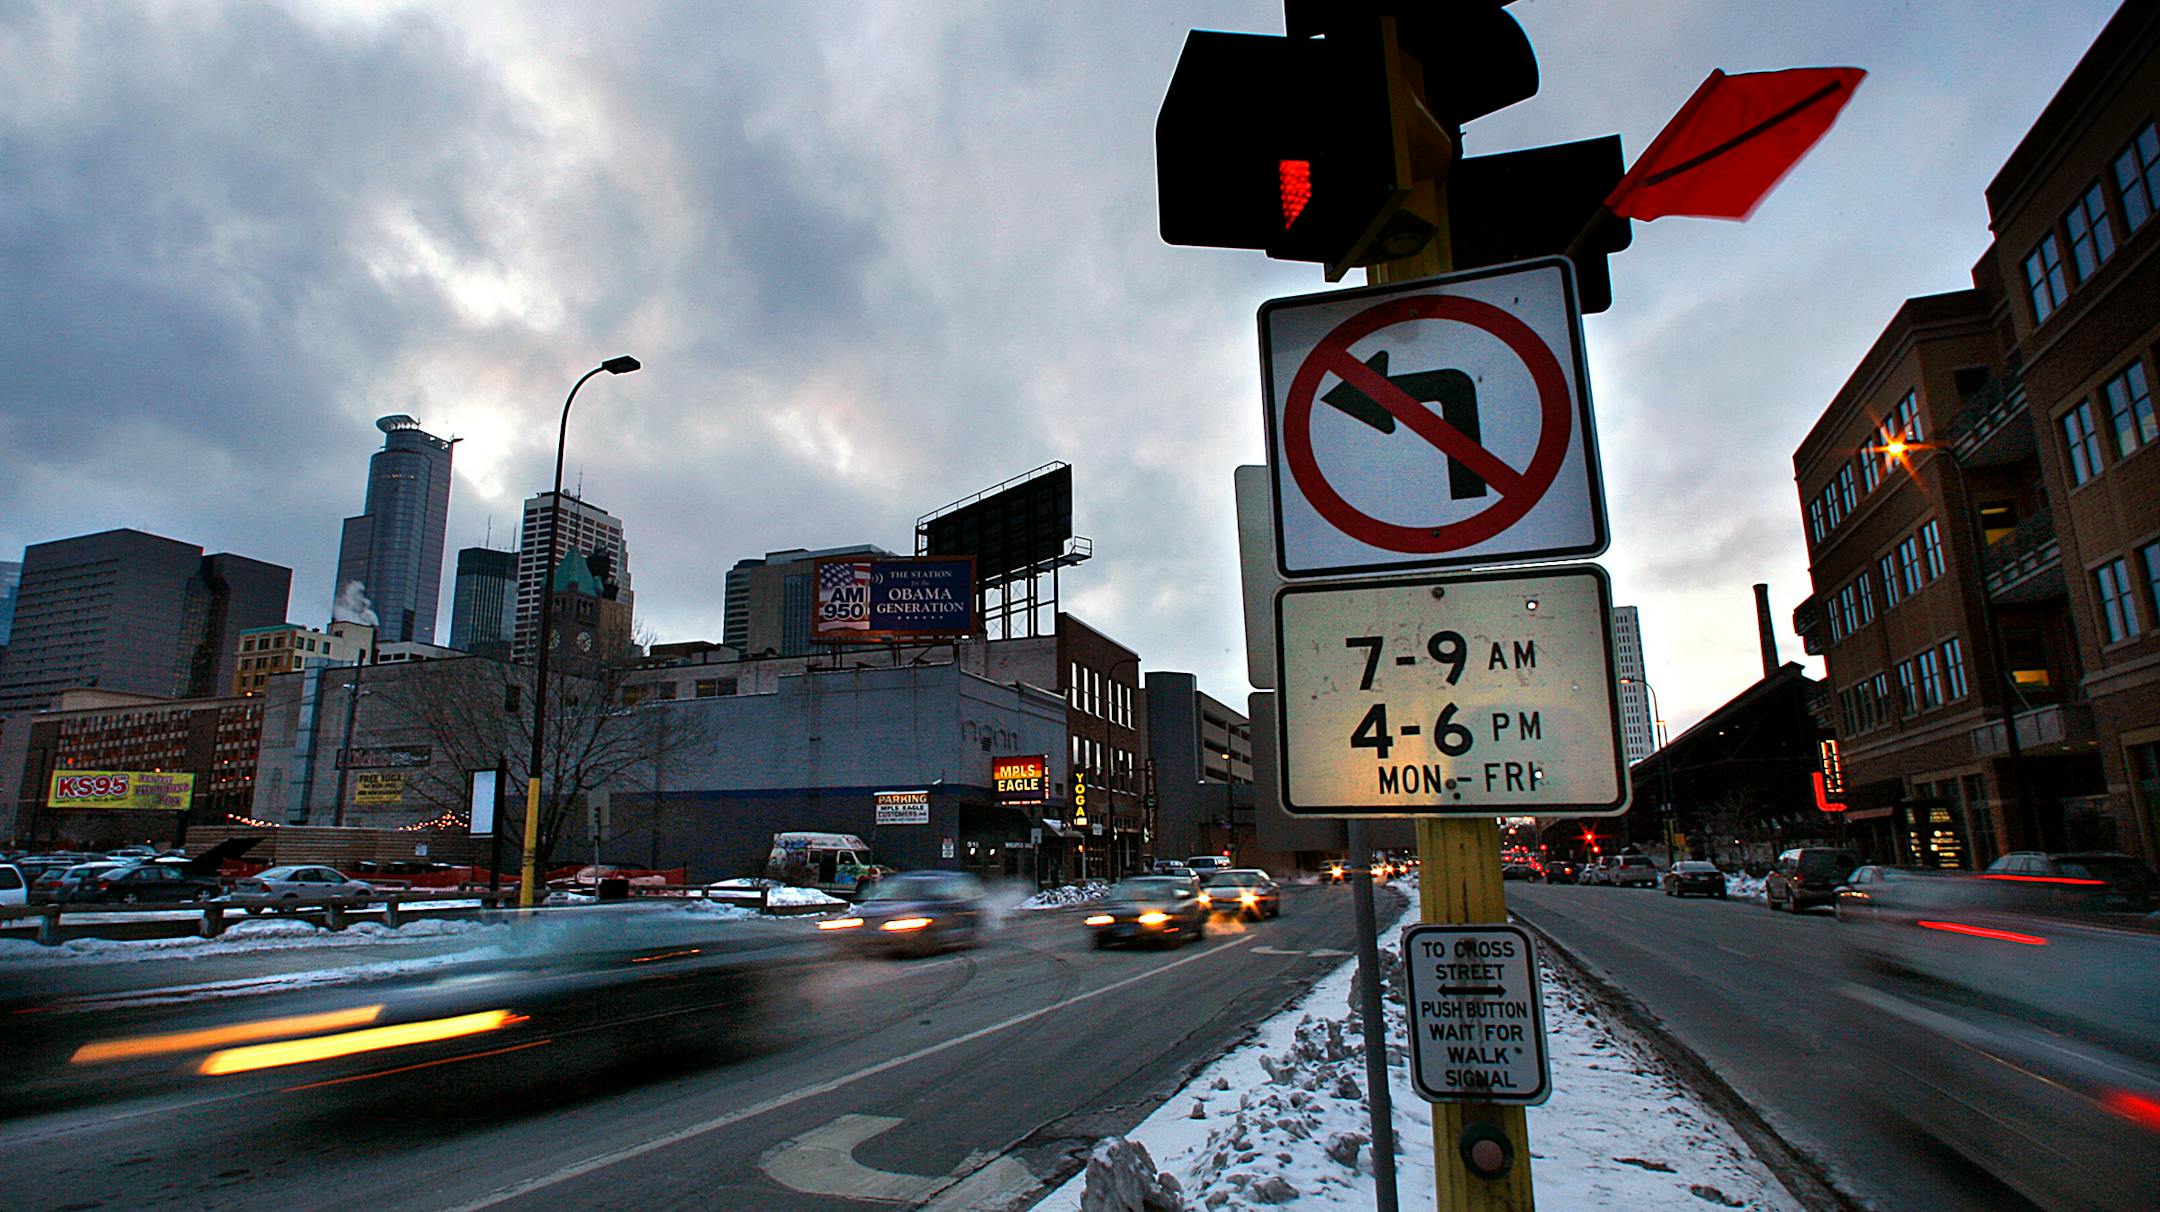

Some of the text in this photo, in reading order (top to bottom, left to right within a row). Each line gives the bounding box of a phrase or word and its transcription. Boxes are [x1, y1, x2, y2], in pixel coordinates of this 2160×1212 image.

[890, 570, 952, 579] THE STATION
[830, 587, 864, 602] AM
[888, 587, 952, 601] OBAMA
[823, 603, 864, 619] 950
[876, 602, 964, 613] GENERATION
[1488, 640, 1536, 670] AM
[1492, 711, 1541, 741] PM
[1000, 764, 1035, 778] MPLS
[57, 775, 129, 798] KS95
[997, 779, 1039, 792] EAGLE
[878, 794, 928, 804] PARKING
[1074, 773, 1086, 816] YOGA
[1422, 941, 1515, 958] TO CROSS
[1436, 964, 1504, 980] STREET
[1421, 1001, 1527, 1018] PUSH BUTTON
[1430, 1024, 1524, 1041] WAIT FOR
[1447, 1047, 1509, 1064] WALK
[1445, 1069, 1517, 1088] SIGNAL
